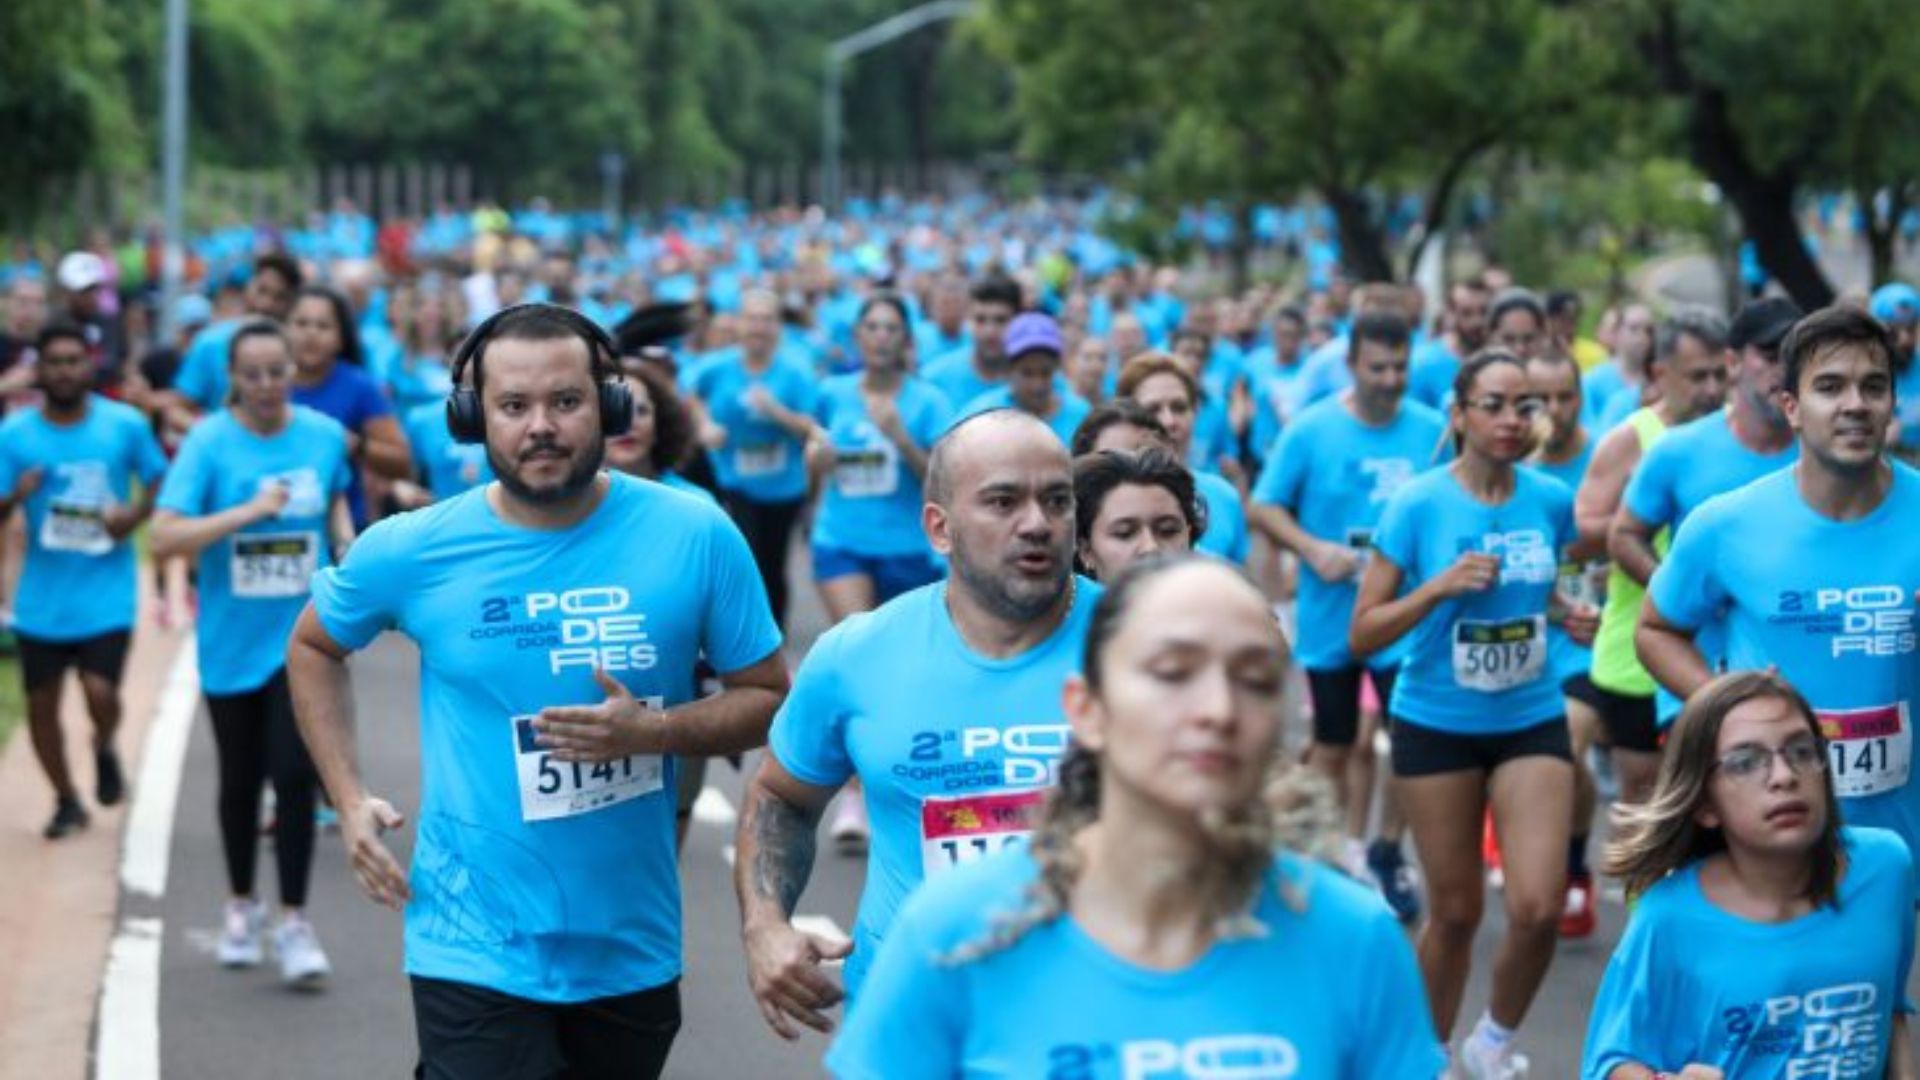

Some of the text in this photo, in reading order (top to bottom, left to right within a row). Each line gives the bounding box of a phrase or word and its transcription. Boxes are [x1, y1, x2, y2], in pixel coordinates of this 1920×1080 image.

[470, 621, 559, 639] CORRIDA
[561, 614, 648, 644] DE
[1844, 608, 1915, 633] DE
[516, 635, 561, 650] DOS
[1832, 632, 1916, 659] RES
[550, 643, 658, 675] RES
[1464, 643, 1531, 676] 5019
[892, 760, 998, 780] CORRIDA
[944, 774, 999, 791] DOS
